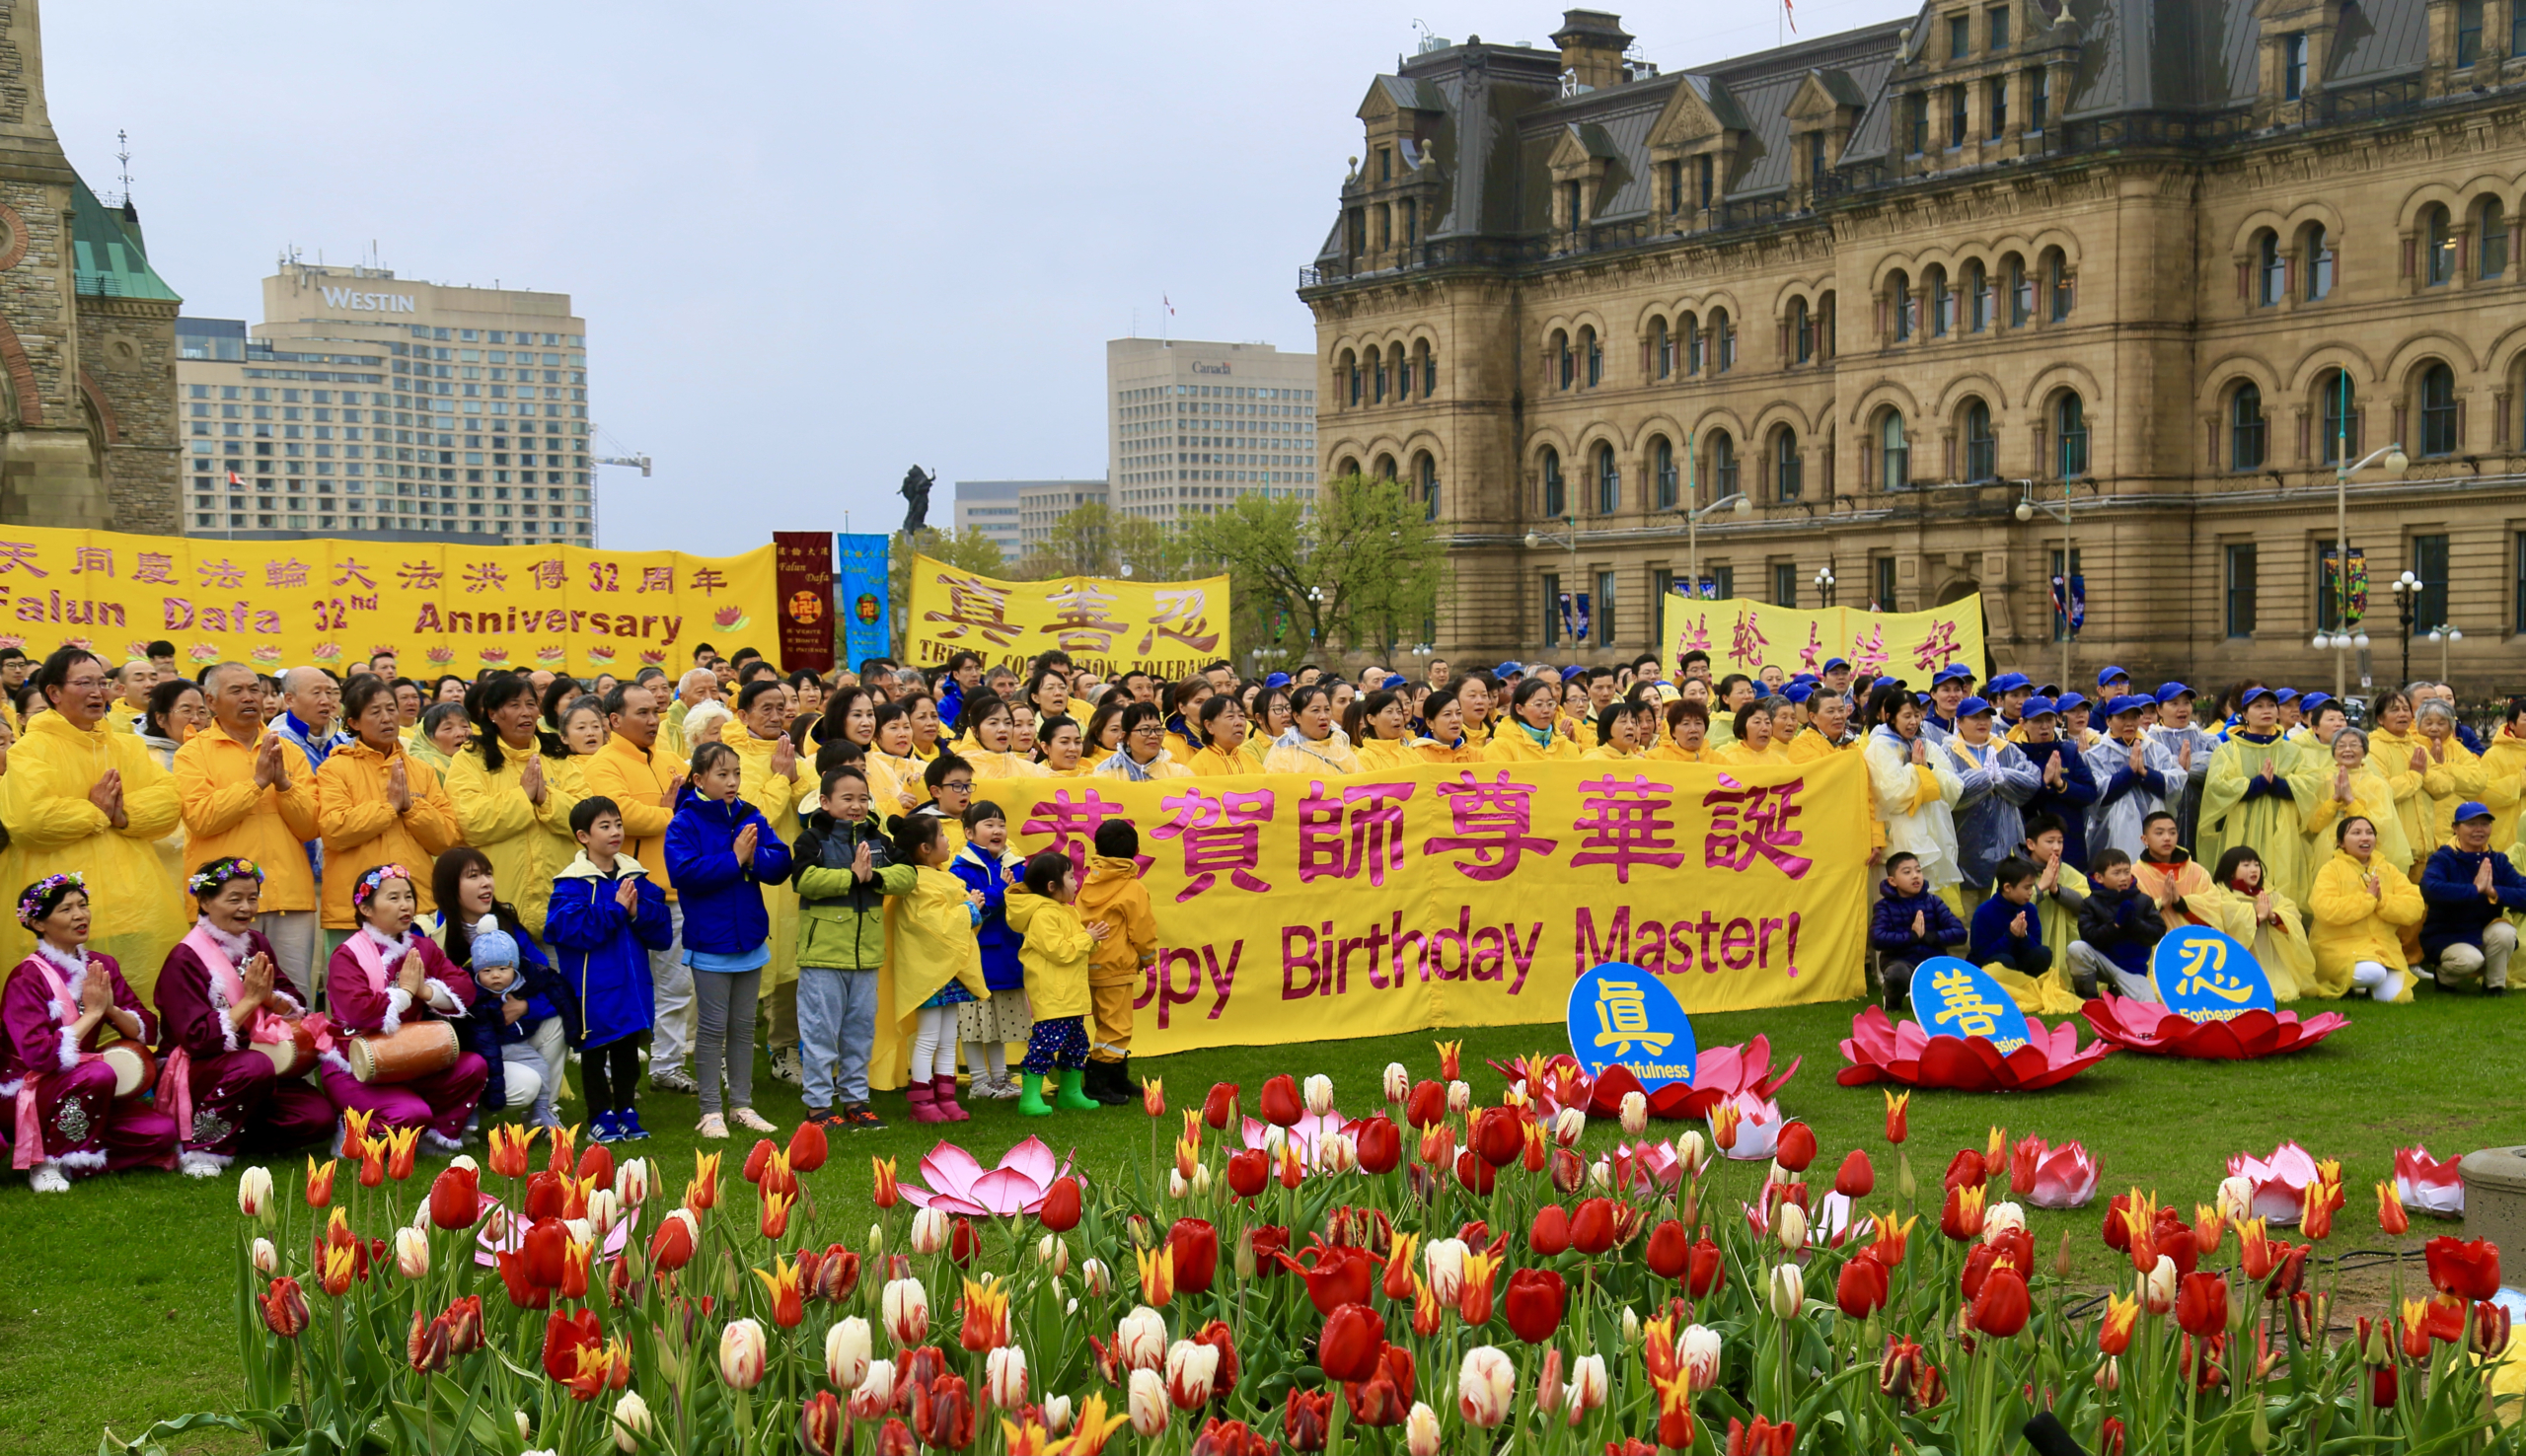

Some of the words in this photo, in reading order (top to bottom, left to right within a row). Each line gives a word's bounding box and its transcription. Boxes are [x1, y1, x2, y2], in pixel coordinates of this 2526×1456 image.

[1192, 360, 1231, 375] Canada
[779, 561, 807, 572] Falun
[804, 571, 830, 585] Dafa
[163, 597, 282, 634] Dafa
[312, 593, 379, 632] 32nd
[413, 602, 684, 647] Anniversary
[924, 573, 1221, 656] 真善忍
[1282, 905, 1543, 1000] Birthday
[1575, 906, 1801, 979] Master!
[2176, 939, 2254, 1003] 忍
[1932, 969, 2004, 1037] 善
